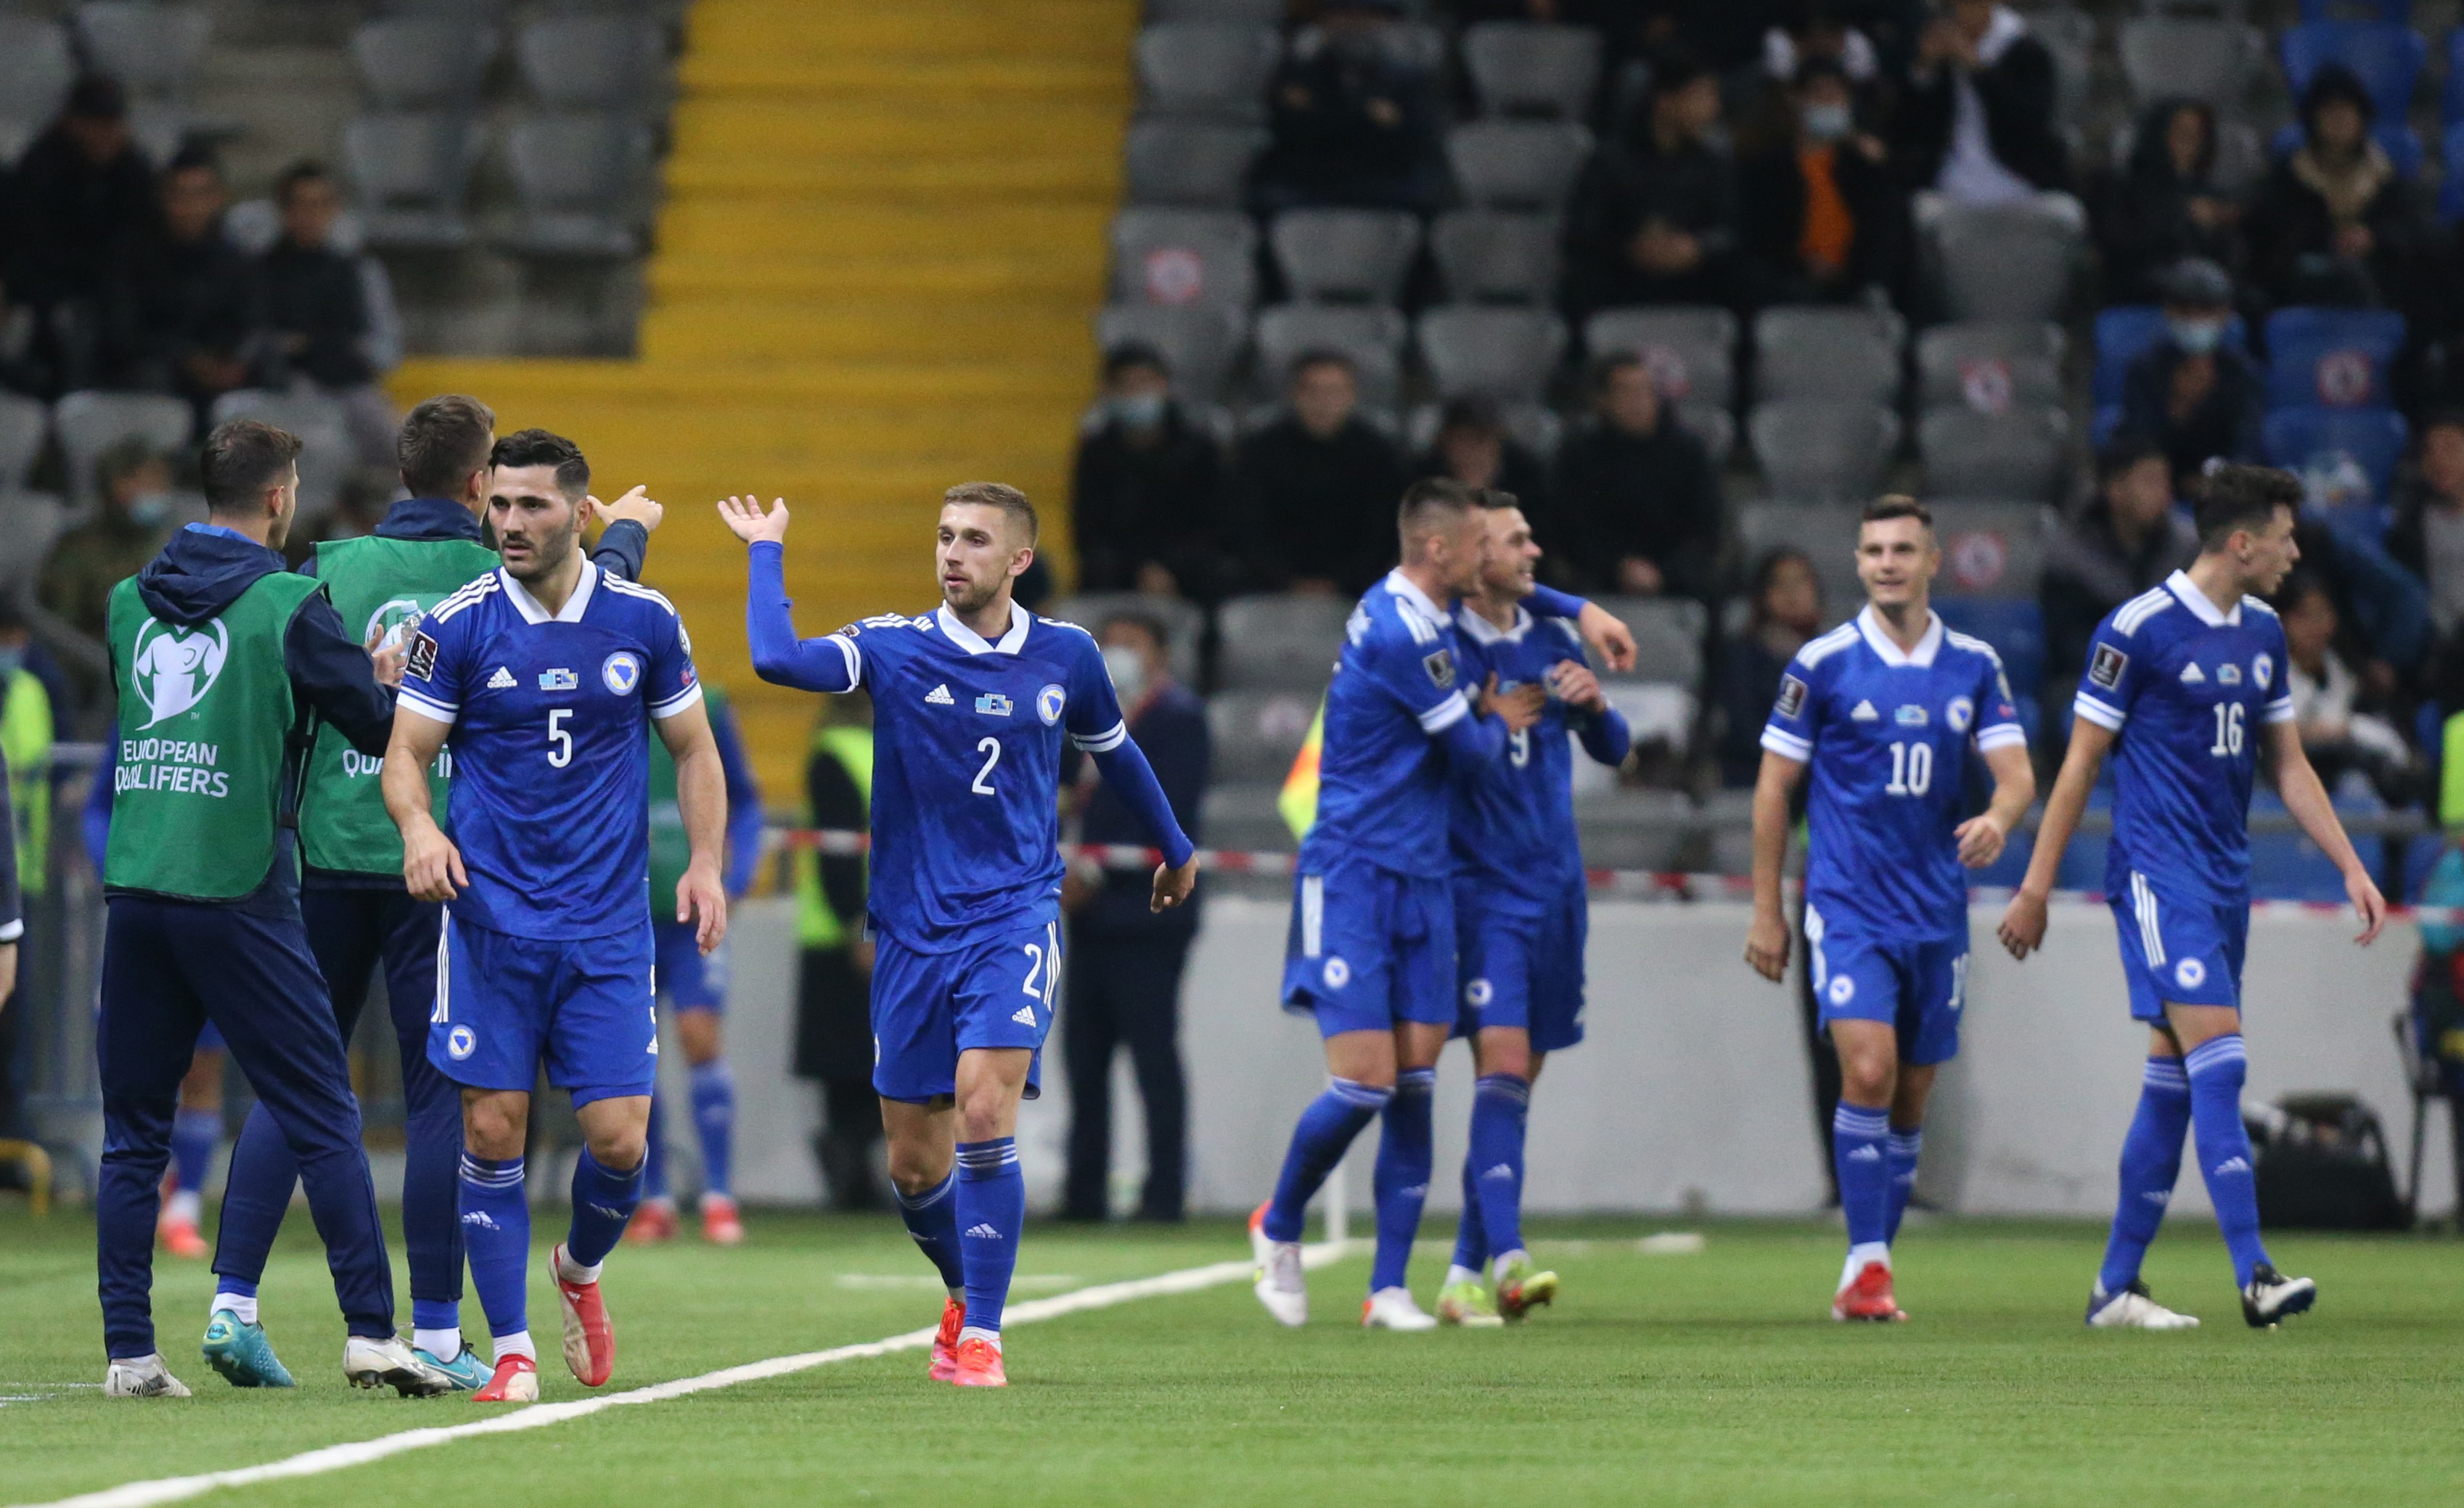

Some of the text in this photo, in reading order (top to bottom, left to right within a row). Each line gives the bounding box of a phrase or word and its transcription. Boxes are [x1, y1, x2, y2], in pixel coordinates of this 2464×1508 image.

[487, 679, 517, 689] adidas
[925, 695, 955, 705] adidas
[547, 708, 573, 768] 5
[2210, 701, 2245, 757] 16
[115, 763, 229, 798] QUALIFIERS
[972, 737, 1001, 795] 2
[1885, 741, 1932, 797] 10
[1023, 943, 1042, 999] 2
[1012, 1014, 1036, 1028] adidas
